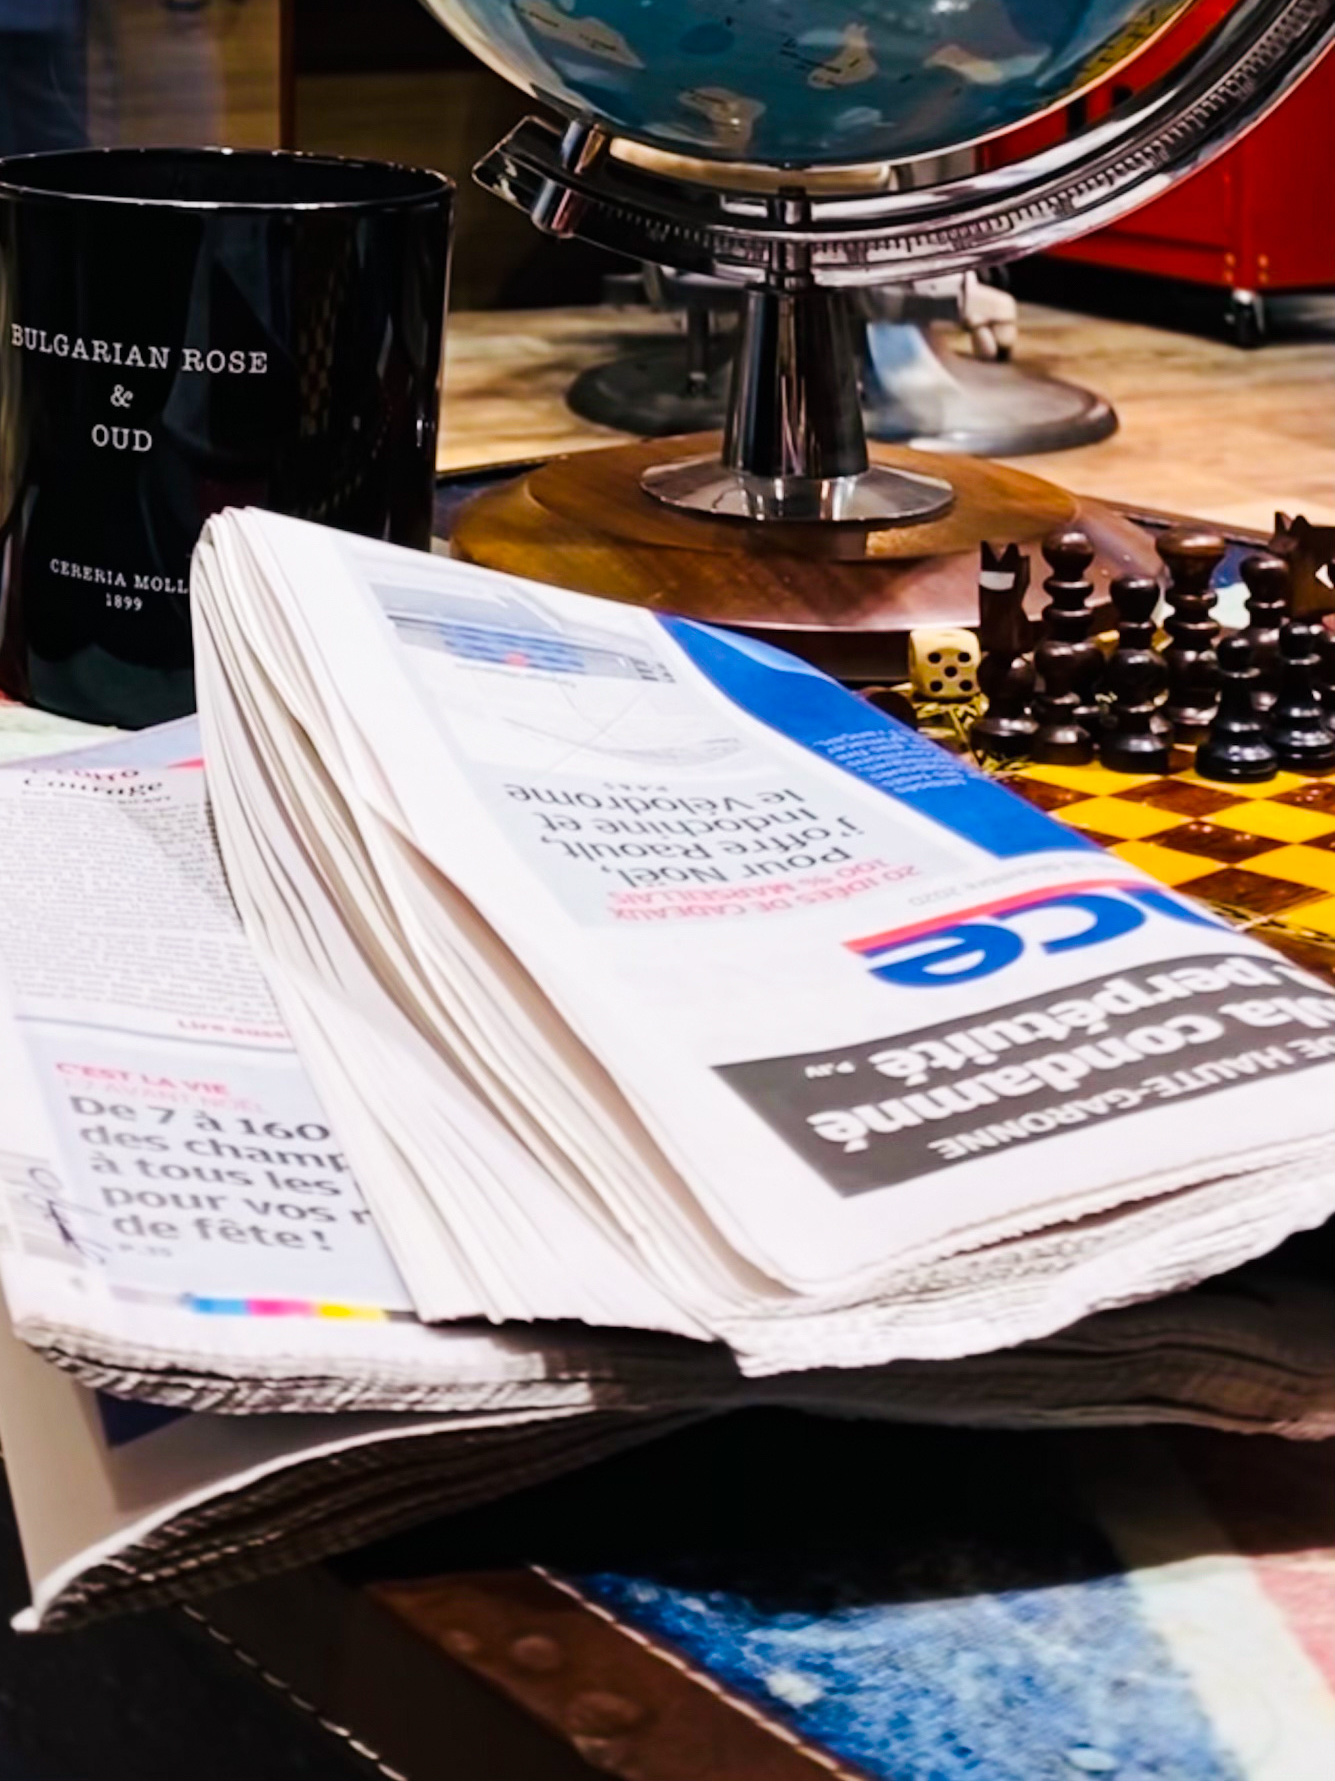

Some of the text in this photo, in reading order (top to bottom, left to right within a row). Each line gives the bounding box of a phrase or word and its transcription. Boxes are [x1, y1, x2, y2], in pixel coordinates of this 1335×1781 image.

[10, 322, 268, 374] BULGARIAN ROSE
[109, 383, 135, 409] &
[90, 423, 153, 453] OUD
[49, 557, 128, 588] CERERIA
[105, 591, 144, 612] 1899
[503, 783, 756, 816] Vélodrome
[756, 788, 806, 803] le
[533, 807, 819, 838] Indochine et
[540, 815, 865, 862] j'offre Raoult,
[599, 846, 853, 888] Pour Noël,
[866, 956, 1283, 1087] perpétuité
[805, 1014, 1225, 1154] condamné
[68, 1095, 332, 1142] De 7 à 160
[926, 1045, 1296, 1160] HAUTE-GARONNE
[79, 1124, 171, 1152] des
[89, 1150, 344, 1197] à tous les
[100, 1186, 227, 1212] pour
[241, 1197, 338, 1224] vos
[111, 1213, 180, 1240] de
